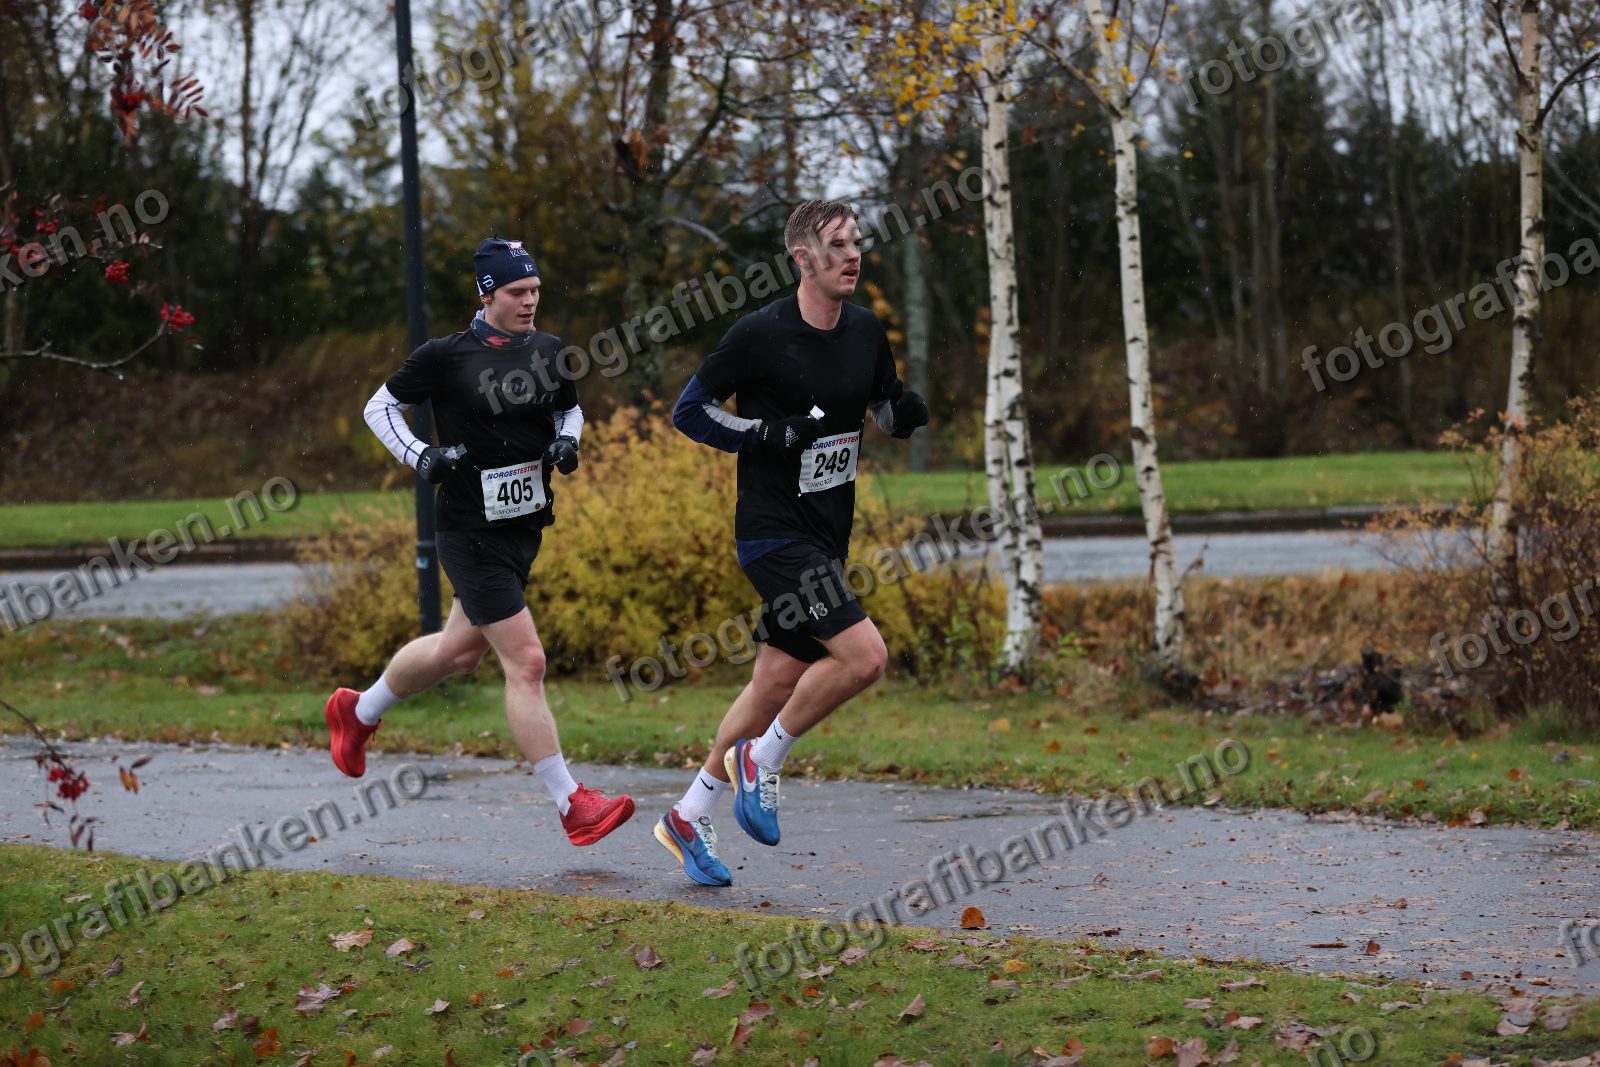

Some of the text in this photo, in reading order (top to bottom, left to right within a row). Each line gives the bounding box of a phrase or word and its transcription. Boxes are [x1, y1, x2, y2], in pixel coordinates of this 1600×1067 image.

[487, 464, 539, 480] NORGESTESTEN
[813, 447, 851, 479] 249
[496, 476, 534, 506] 405
[808, 602, 828, 620] 13
